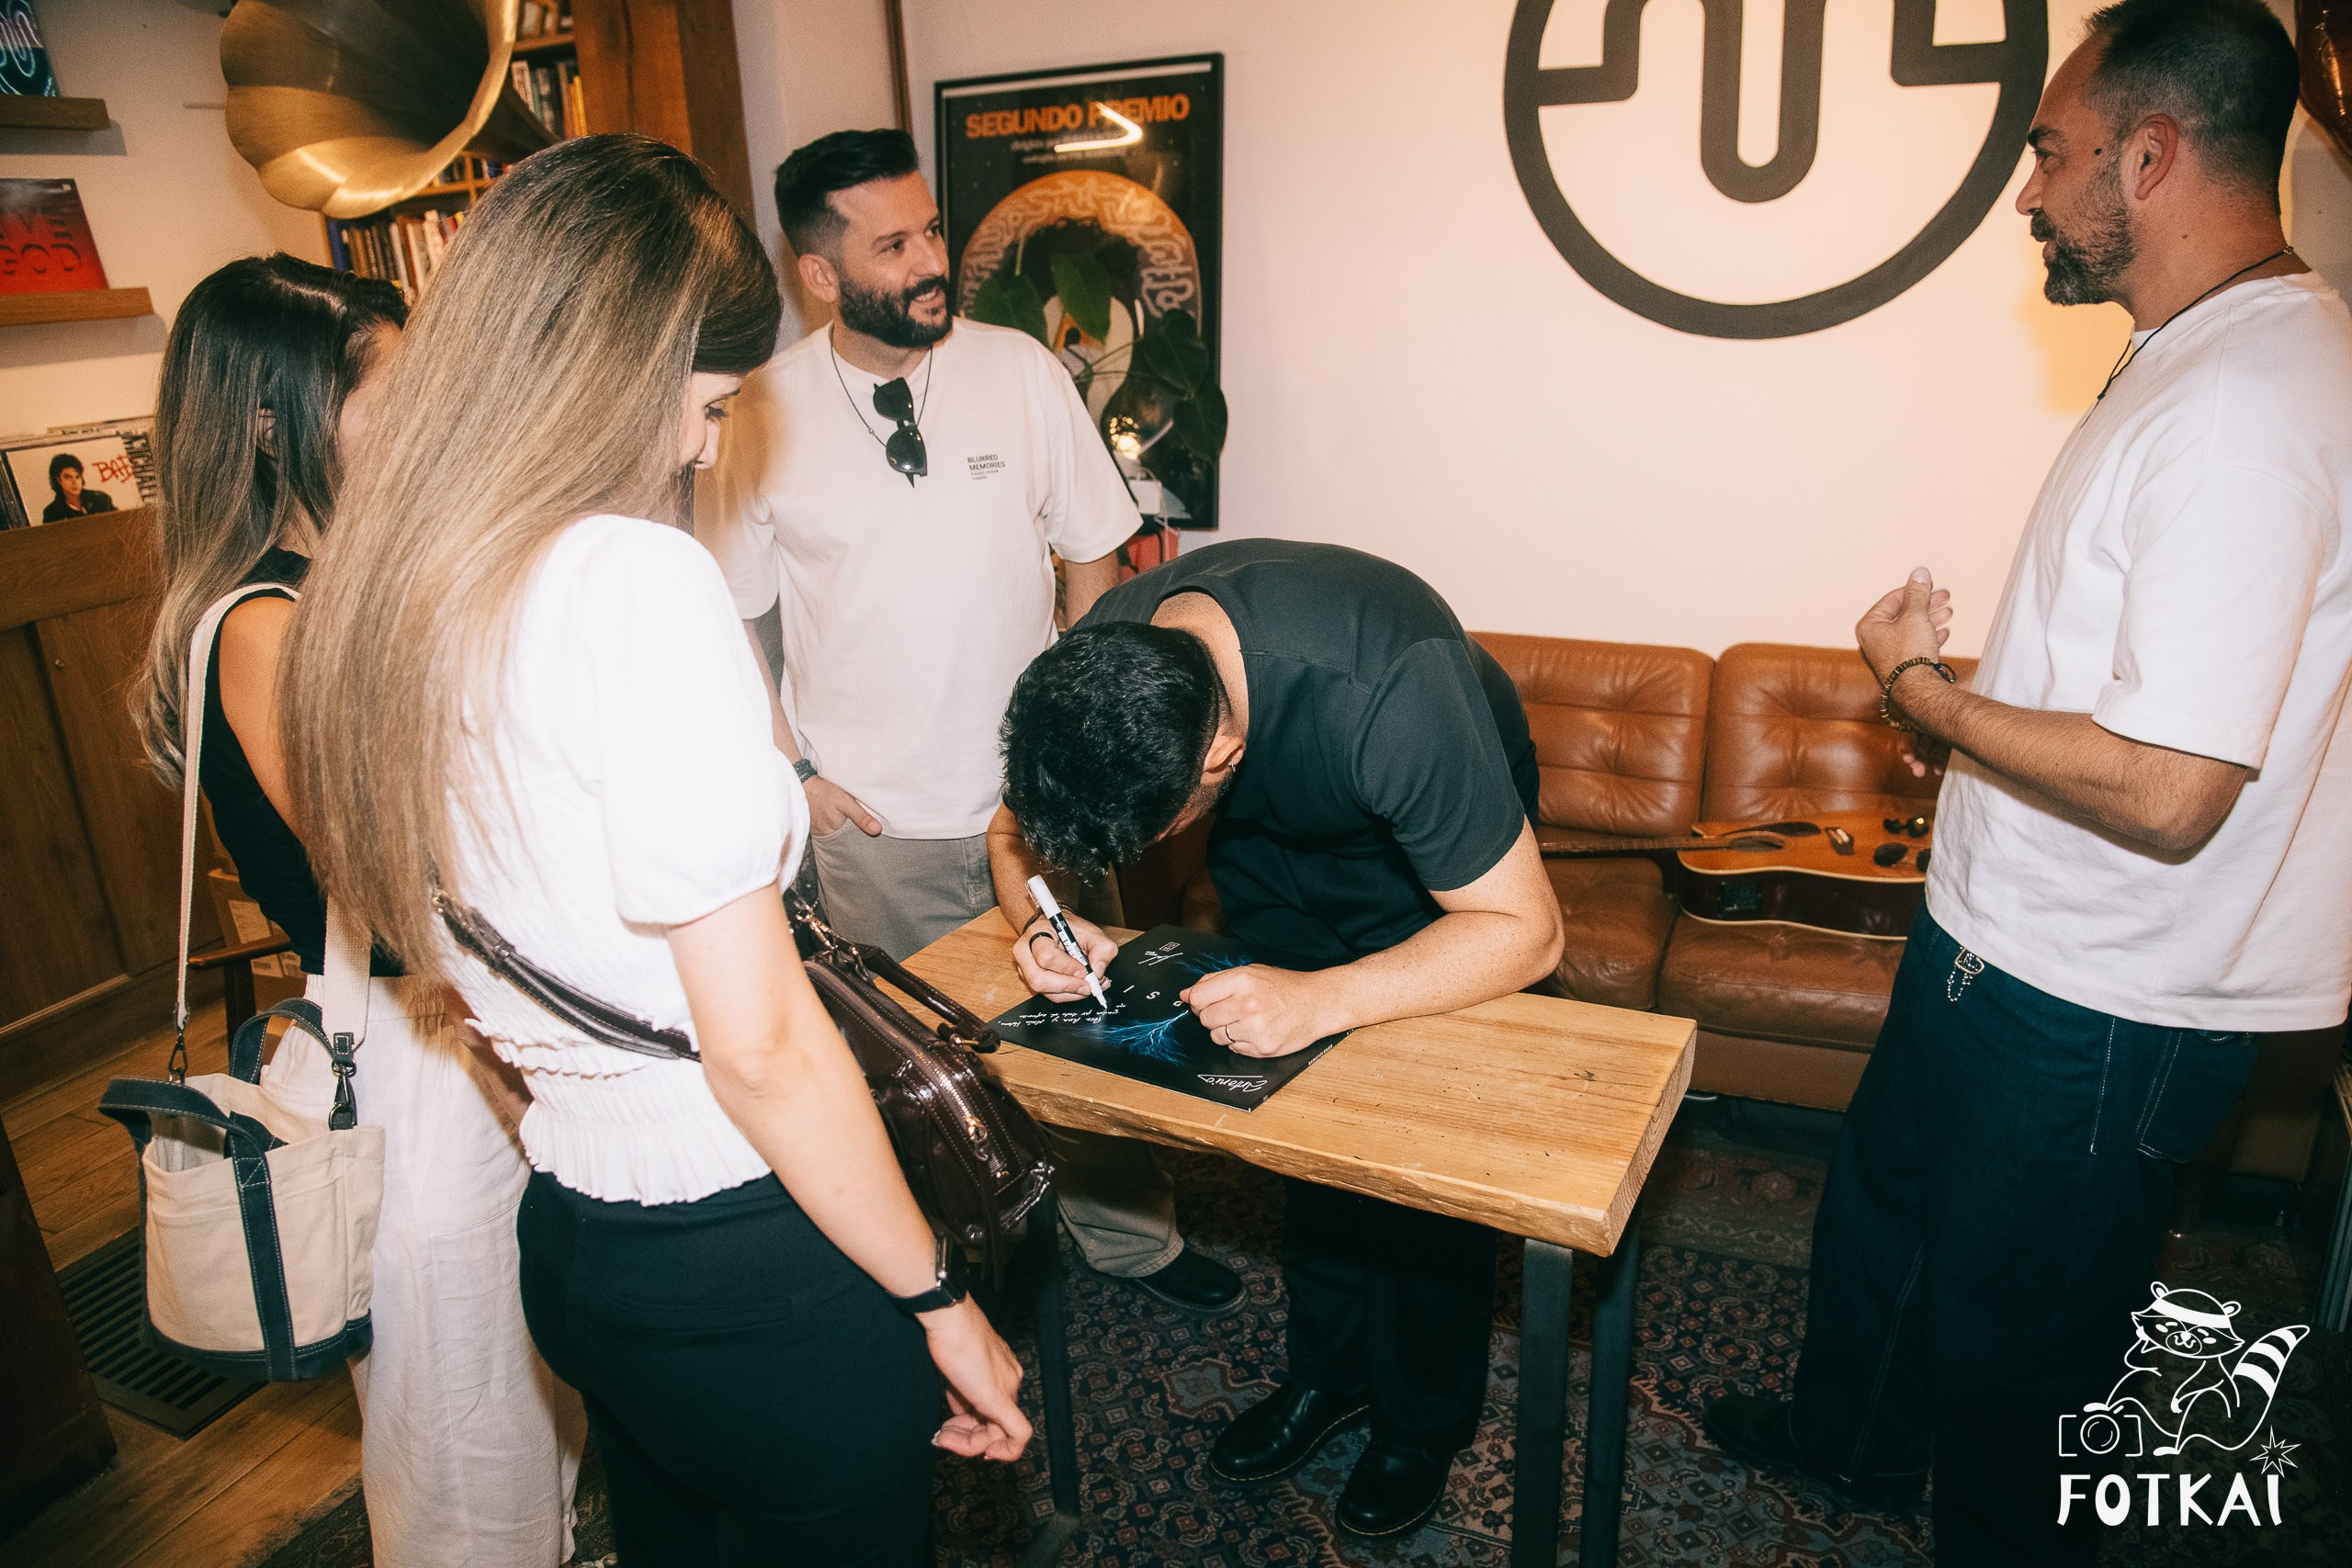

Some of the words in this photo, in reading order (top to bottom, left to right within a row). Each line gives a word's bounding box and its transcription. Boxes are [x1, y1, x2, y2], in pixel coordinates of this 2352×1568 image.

[966, 104, 1083, 139] SEGUNDO
[967, 454, 999, 463] BLURRED
[969, 461, 1006, 470] MEMORIES
